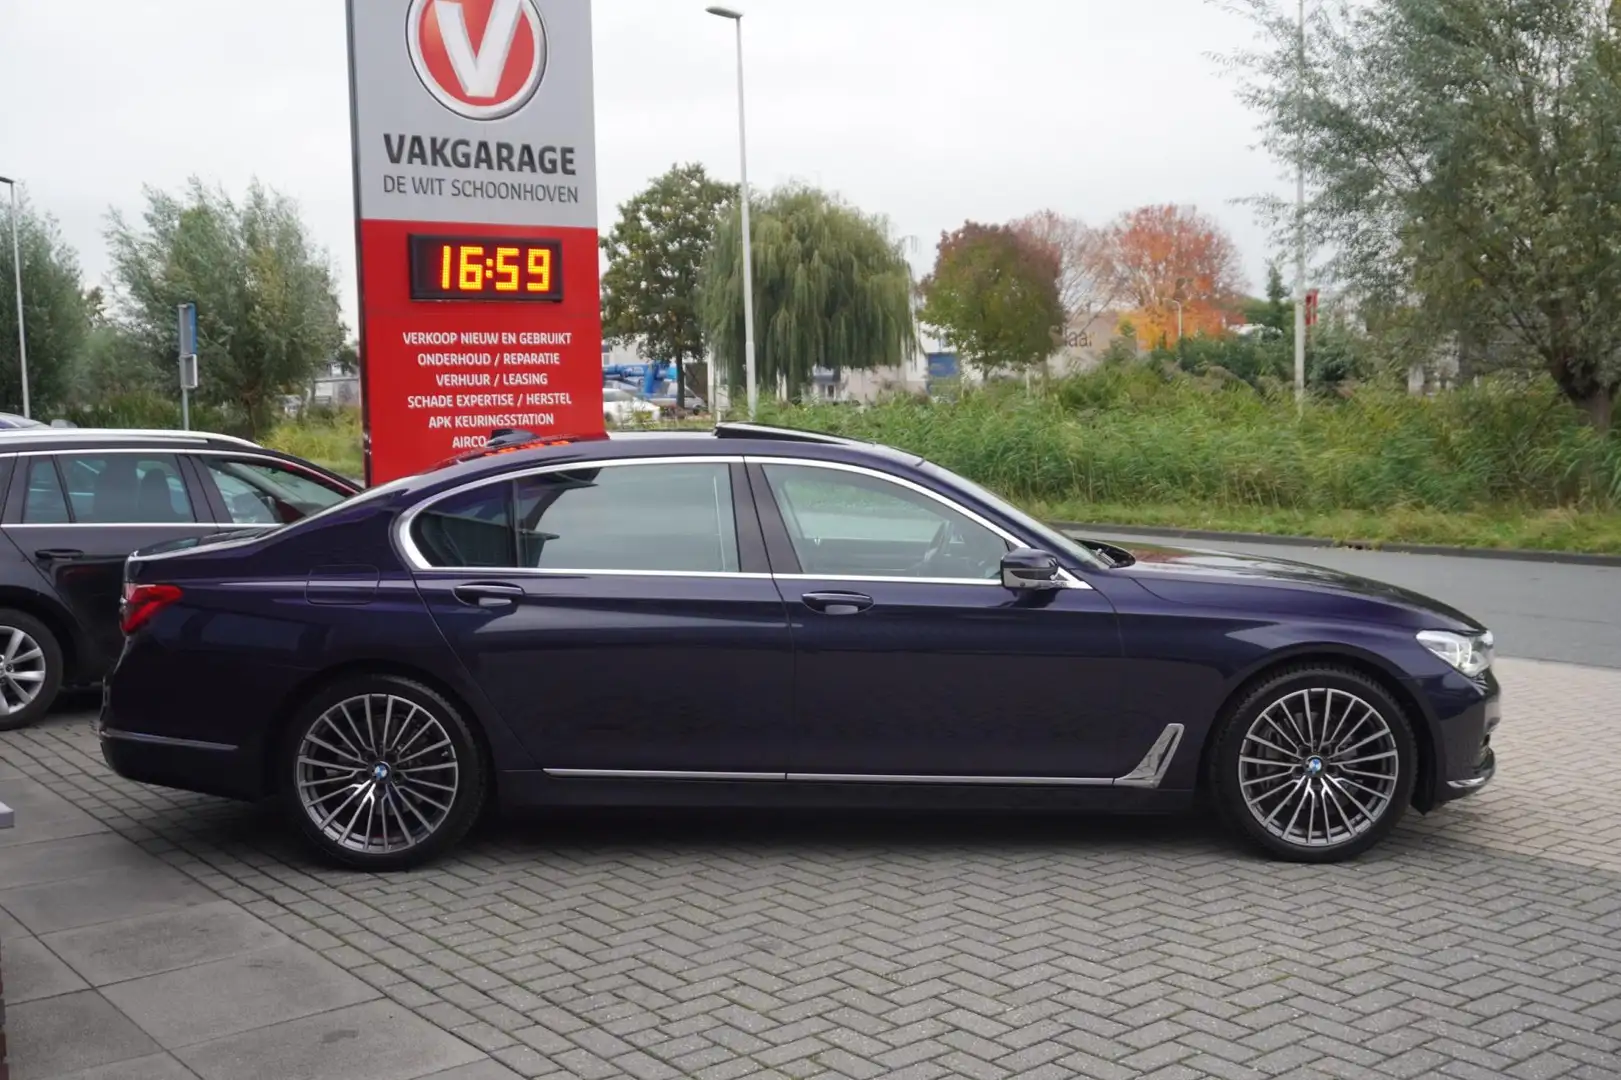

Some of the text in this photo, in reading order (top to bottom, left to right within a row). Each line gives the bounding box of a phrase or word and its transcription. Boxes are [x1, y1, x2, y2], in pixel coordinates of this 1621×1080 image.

[433, 0, 523, 98] V
[383, 133, 577, 176] VAKGARAGE
[383, 175, 578, 204] DE WIT SCHOONHOVEN
[441, 246, 550, 291] 16:59
[402, 332, 572, 345] VERKOOP NIEUW EN GEBRUIKT
[417, 353, 560, 367] ONDERHOUD / REPARATIE
[435, 373, 549, 387] VERHUUR / LEASING
[407, 393, 573, 409] SCHADE EXPERTISE / HERSTEL
[428, 413, 555, 429] APK KEURINGSSTATION
